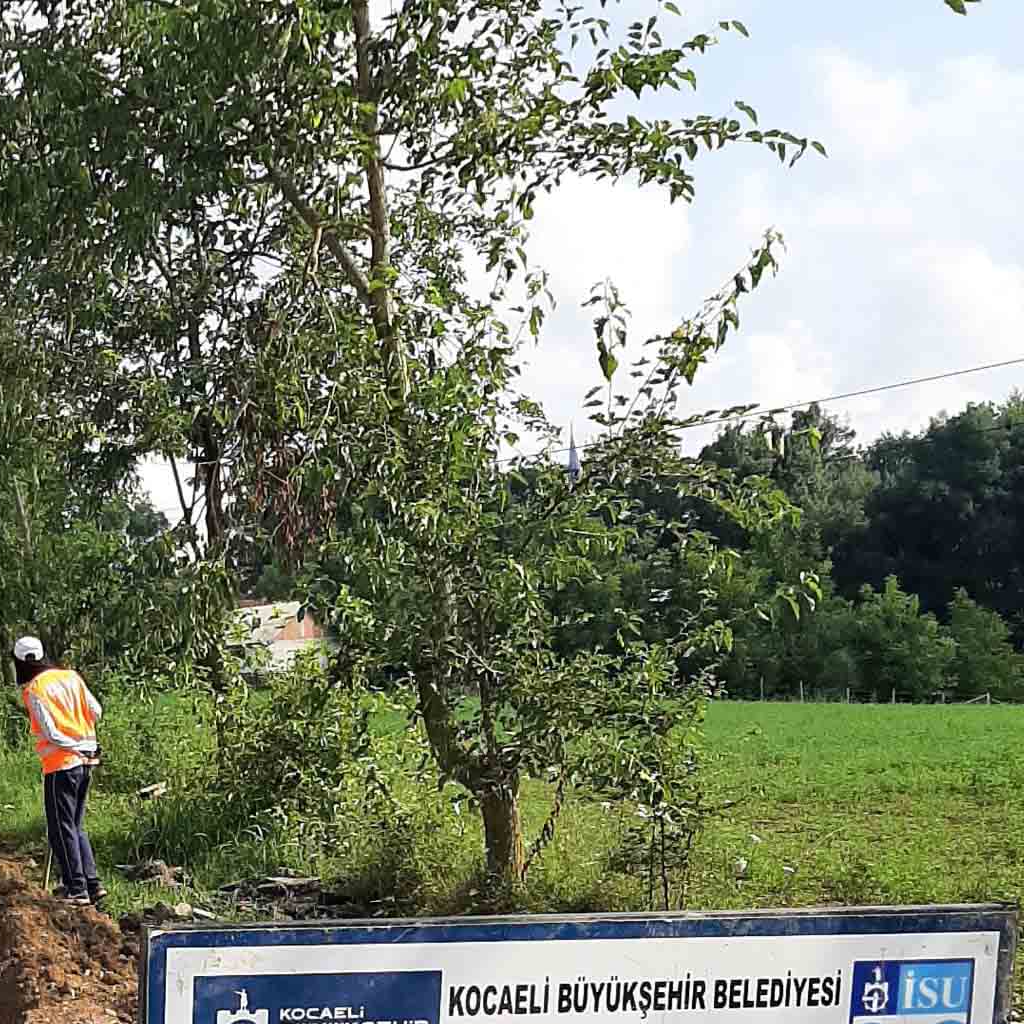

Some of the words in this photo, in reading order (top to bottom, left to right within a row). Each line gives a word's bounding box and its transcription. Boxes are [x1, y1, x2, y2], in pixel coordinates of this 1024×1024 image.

[448, 976, 550, 1017] KOCAELİ
[557, 972, 706, 1020] BÜYÜKŞEHİR
[713, 969, 842, 1010] BELEDİYESİ
[902, 969, 969, 1010] İSU
